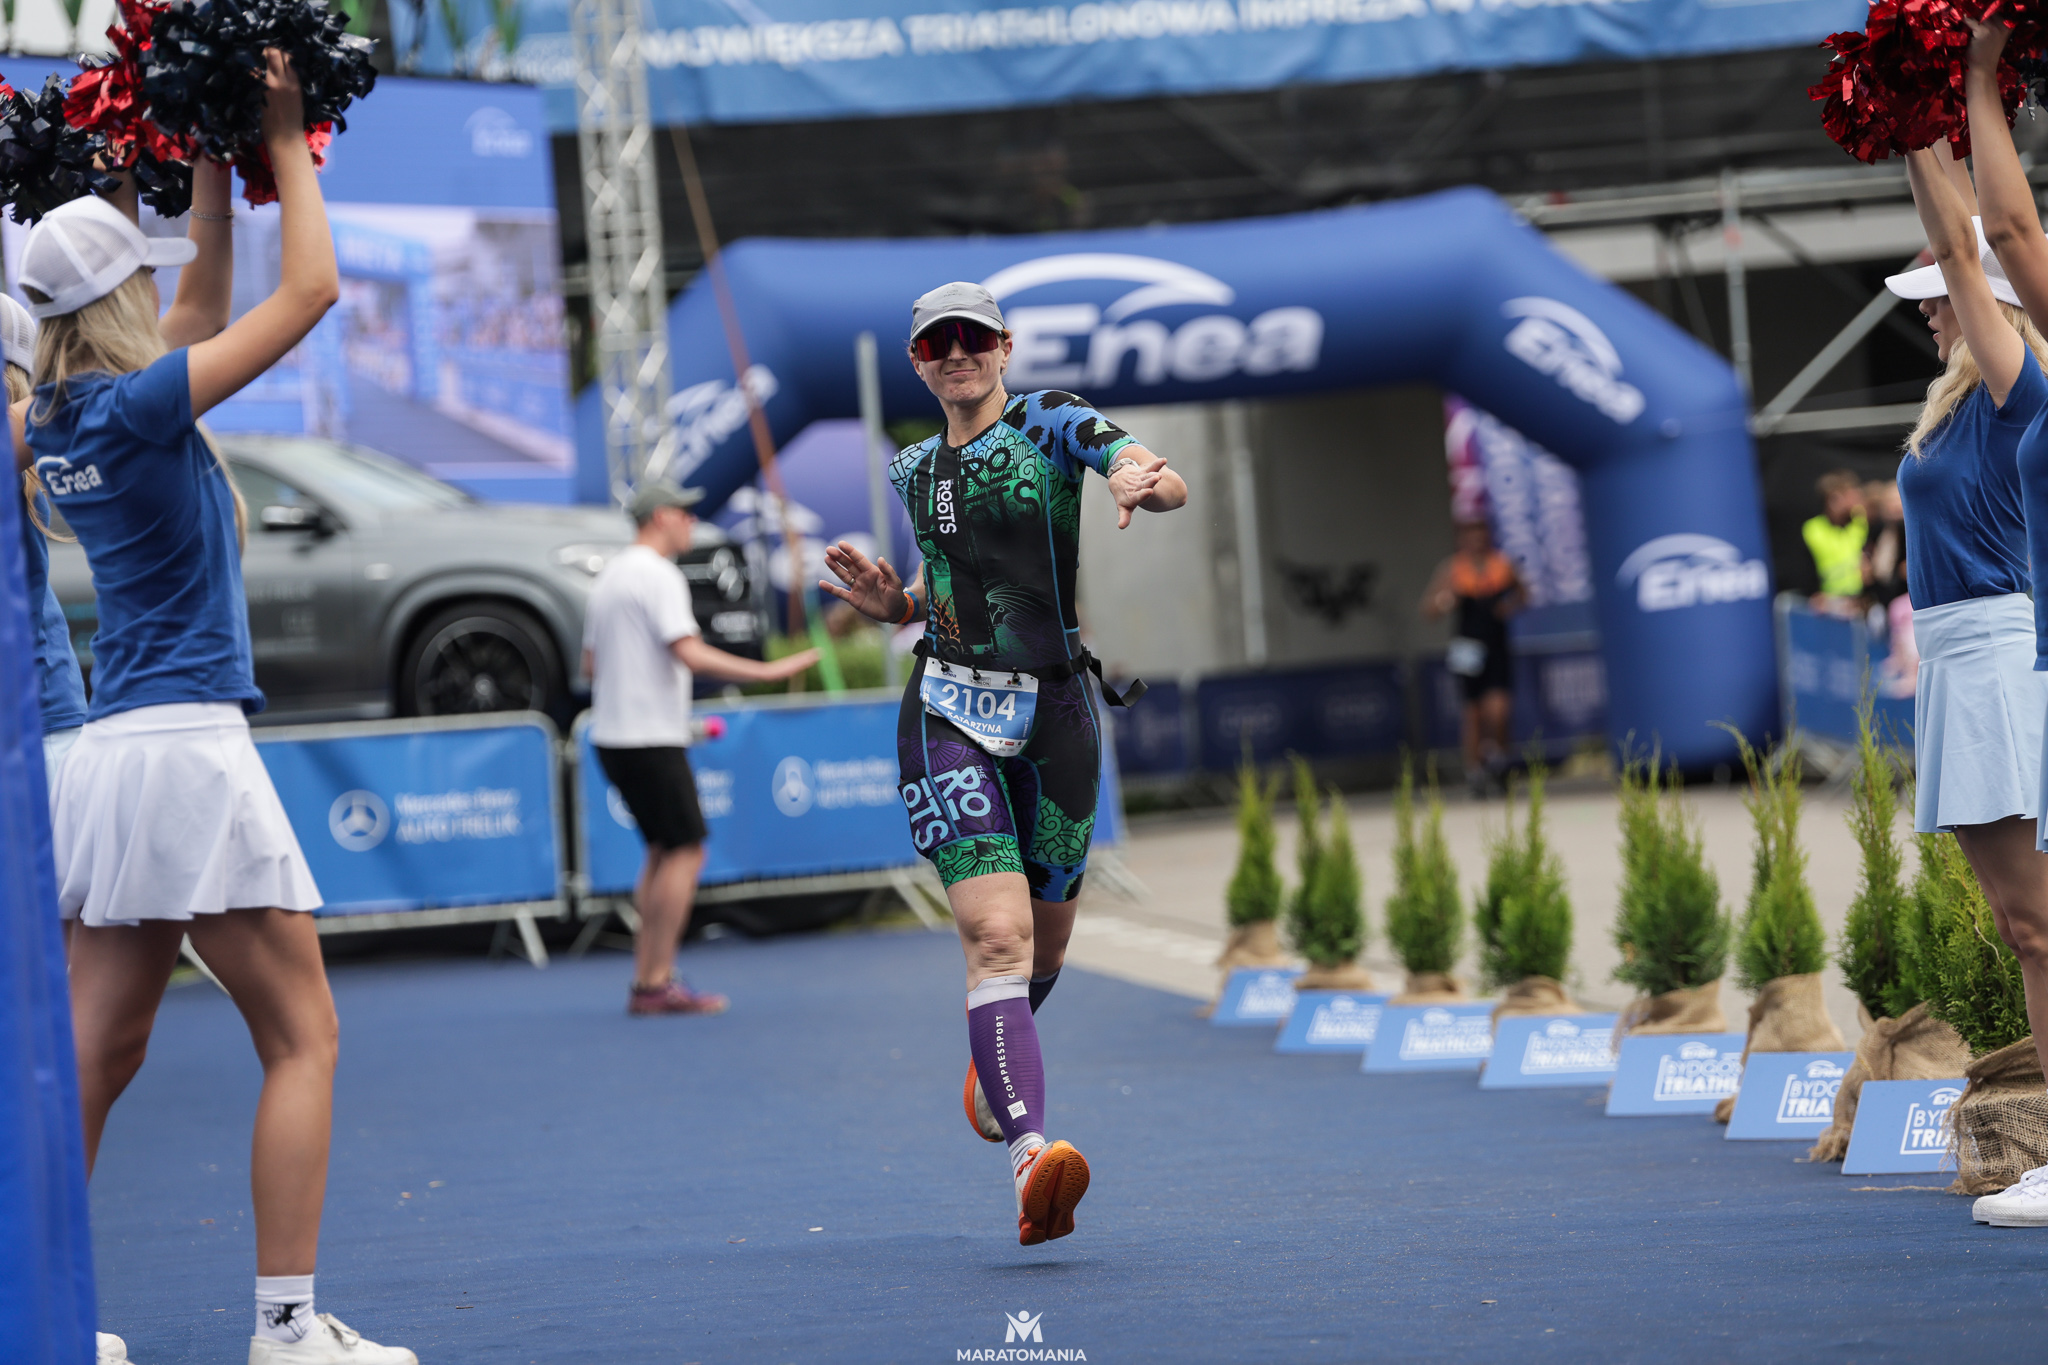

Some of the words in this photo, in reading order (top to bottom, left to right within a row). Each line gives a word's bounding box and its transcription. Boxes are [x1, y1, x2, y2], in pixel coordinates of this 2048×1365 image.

[1002, 303, 1325, 392] Enea
[45, 464, 103, 495] Enea
[936, 480, 957, 534] ROOTS
[938, 683, 1016, 721] 2104
[946, 710, 1003, 734] KATARZYNA
[996, 1014, 1017, 1099] COMPRESSPORT
[1786, 1097, 1835, 1117] TRIA
